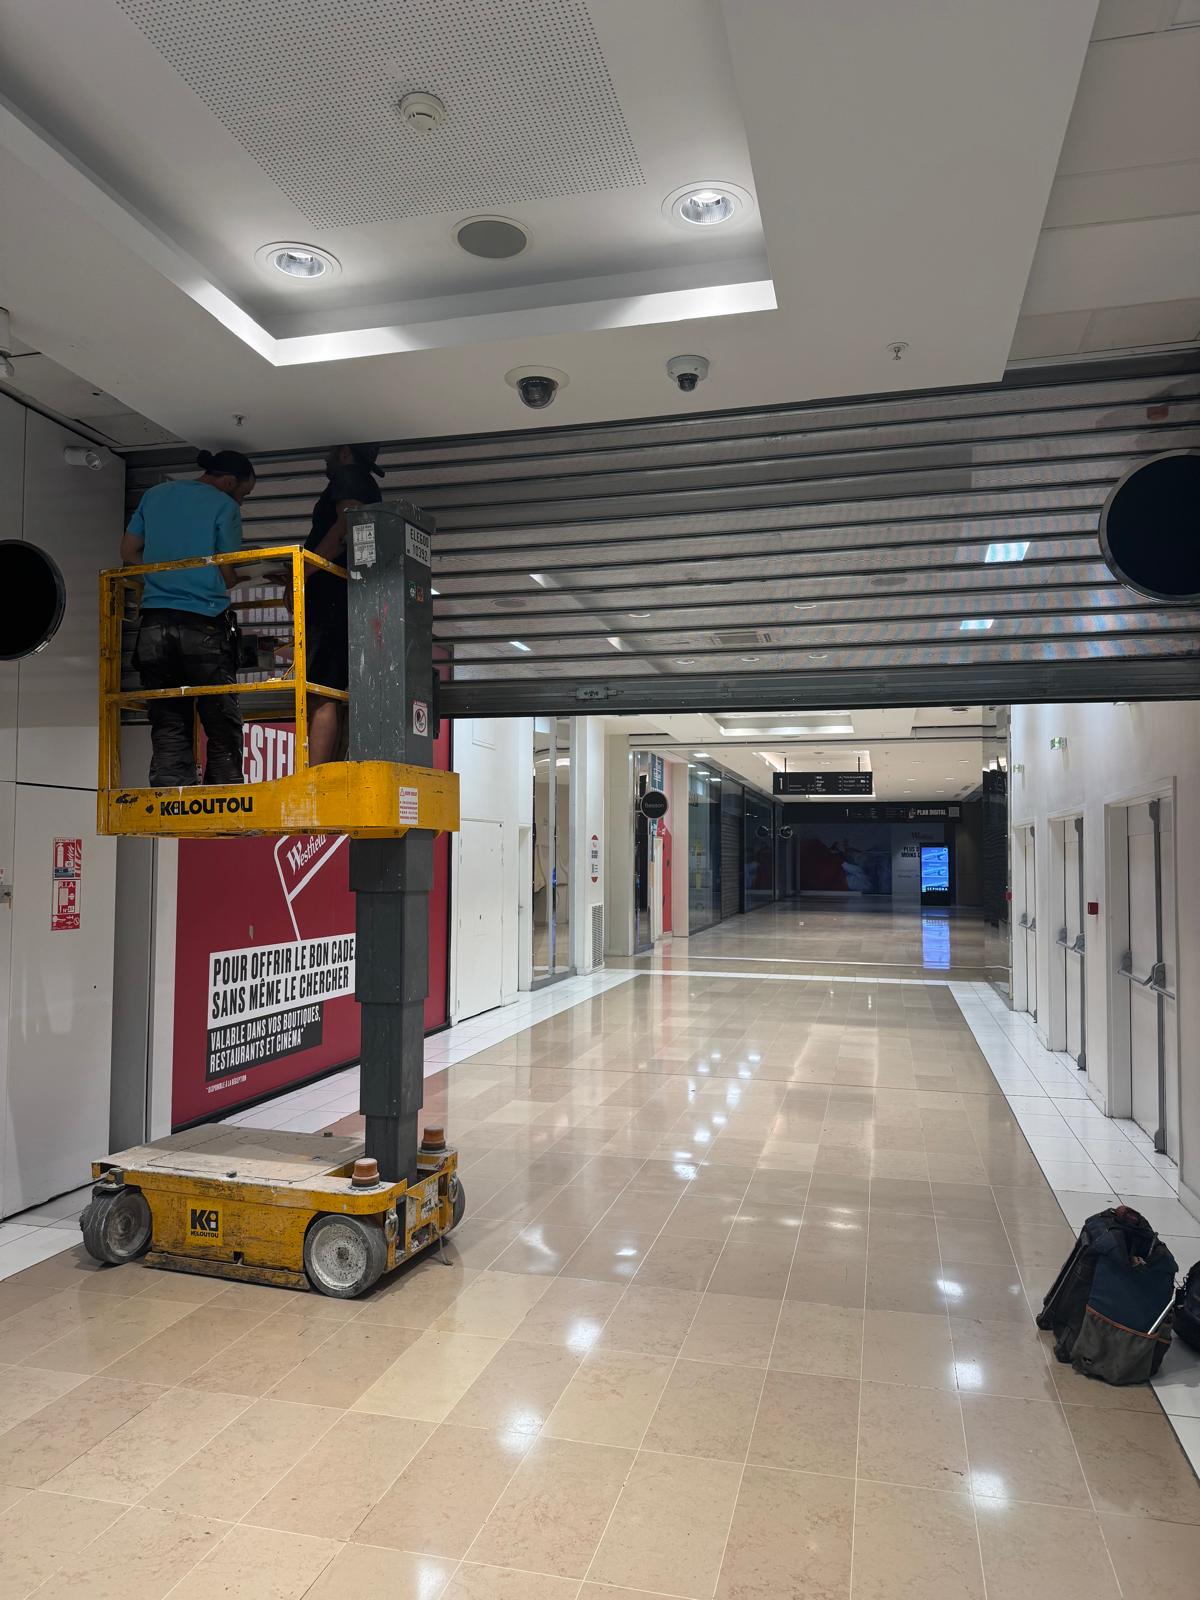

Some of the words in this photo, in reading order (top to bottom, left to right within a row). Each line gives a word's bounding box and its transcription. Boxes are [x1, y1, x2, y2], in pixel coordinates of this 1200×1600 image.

[242, 724, 294, 783] ESTFI
[160, 796, 253, 816] KILOUTOU
[213, 954, 248, 987] POUR
[251, 948, 292, 980] OFFRIR
[295, 944, 306, 972] LE
[309, 942, 329, 969] BON
[331, 938, 357, 965] CADE
[211, 986, 246, 1020] SANS
[249, 978, 282, 1011] MÊME
[284, 976, 297, 1002] LE
[299, 966, 349, 999] CHERCHER
[209, 1031, 265, 1073] RESTAURANTS
[266, 1036, 275, 1055] ET
[210, 1024, 245, 1052] VALABLE
[247, 1016, 267, 1038] DANS
[268, 1014, 282, 1034] VOS
[283, 1005, 321, 1029] BOUTIQUES,
